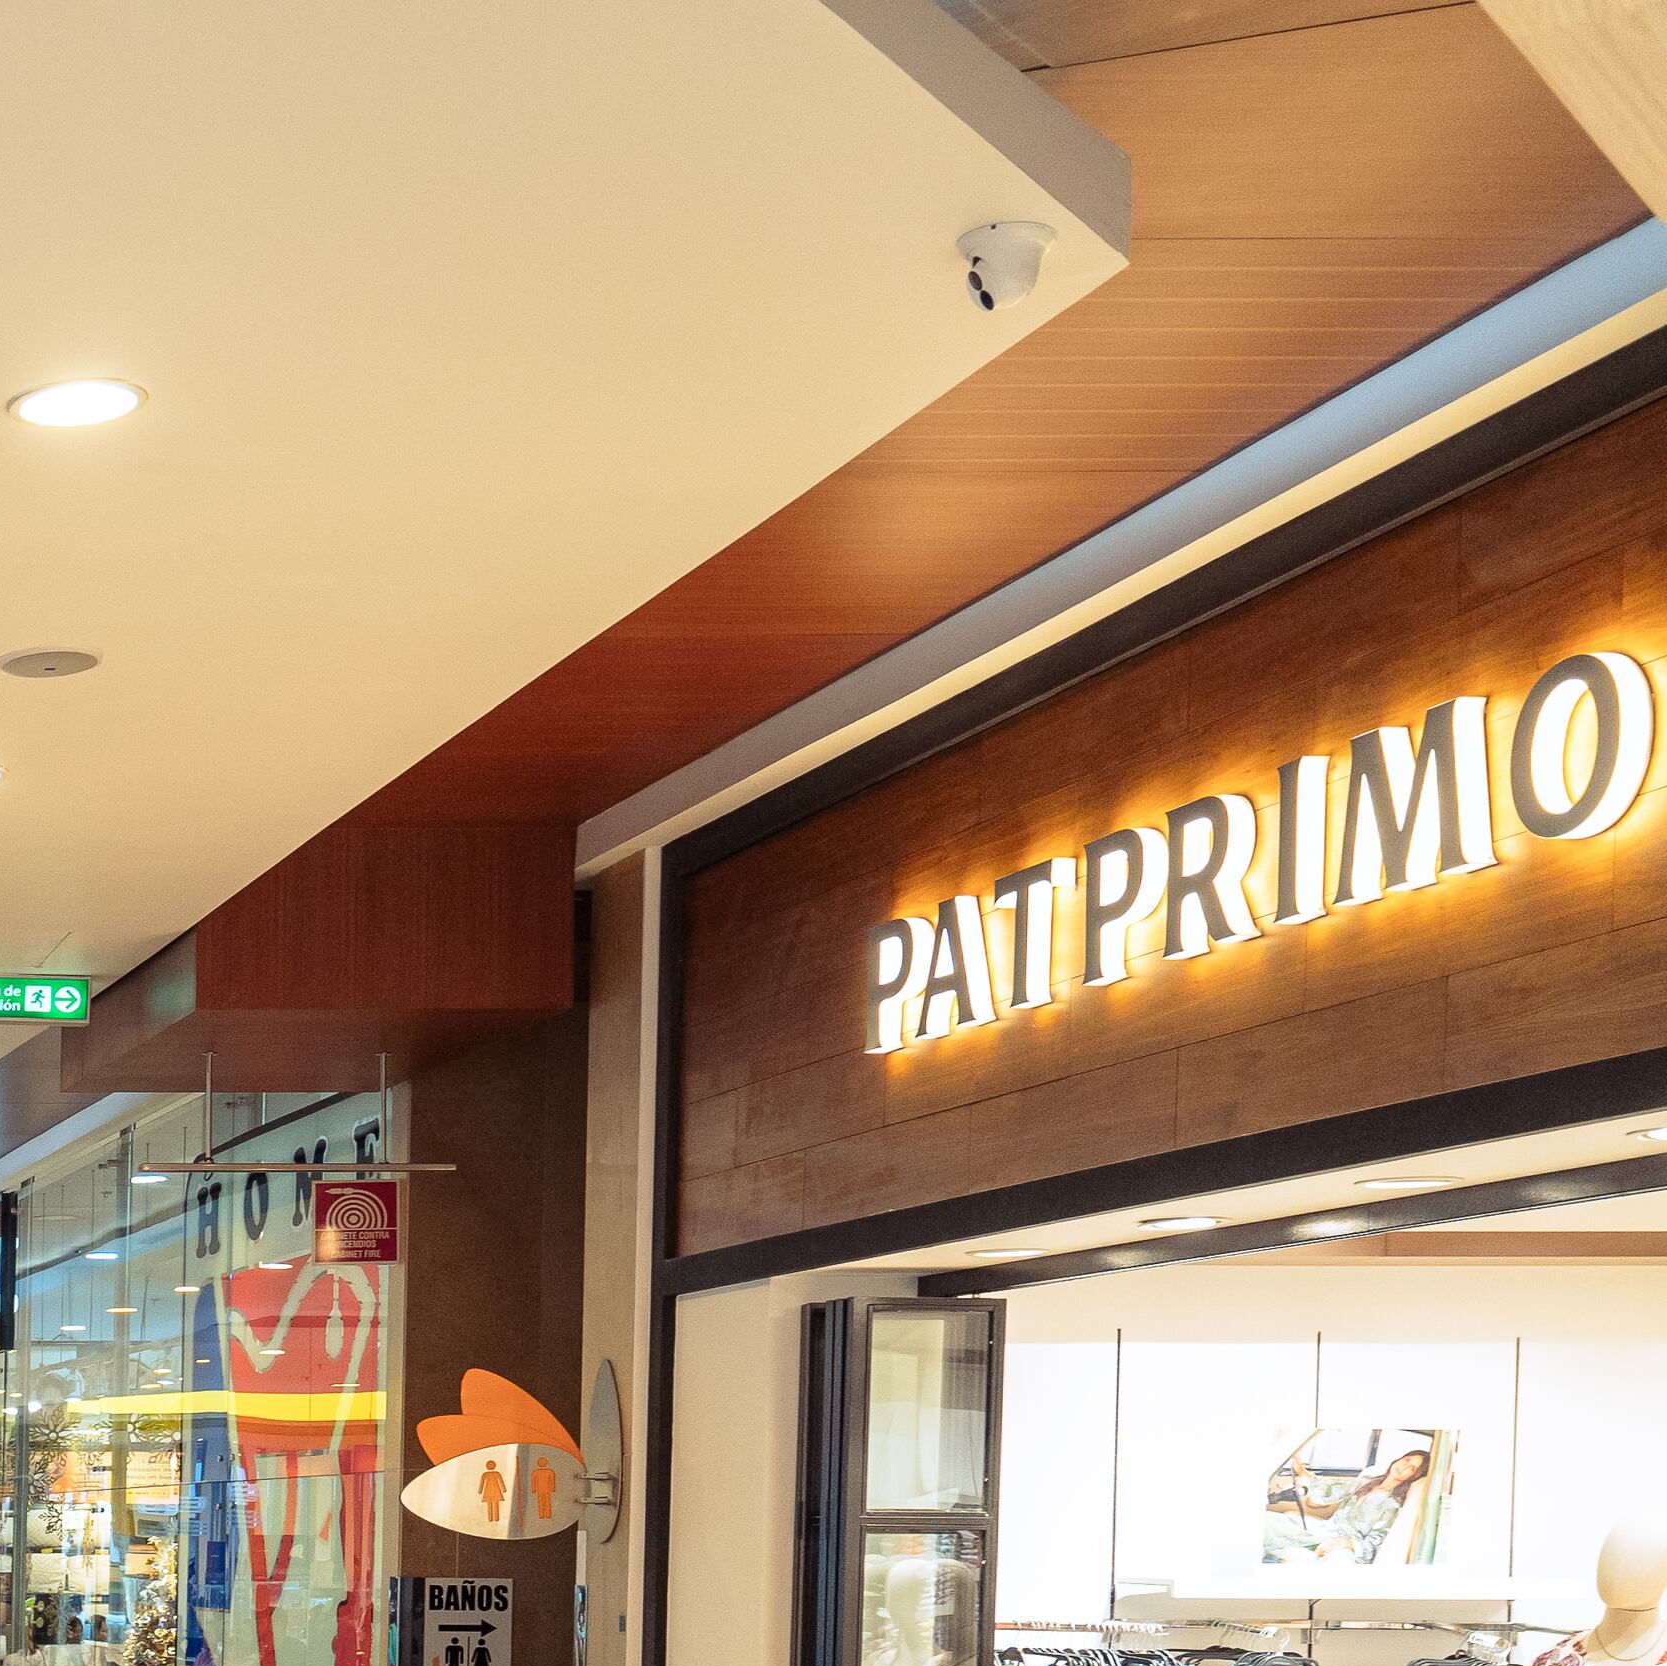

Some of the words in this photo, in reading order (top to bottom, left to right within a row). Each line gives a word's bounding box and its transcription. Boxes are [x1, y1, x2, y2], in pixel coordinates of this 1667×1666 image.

[864, 652, 1654, 1054] PATPRIMO
[4, 985, 21, 997] de
[359, 1231, 390, 1240] CONTRA
[336, 1239, 377, 1248] NCENDIOS
[429, 1580, 509, 1612] BAÑOS
